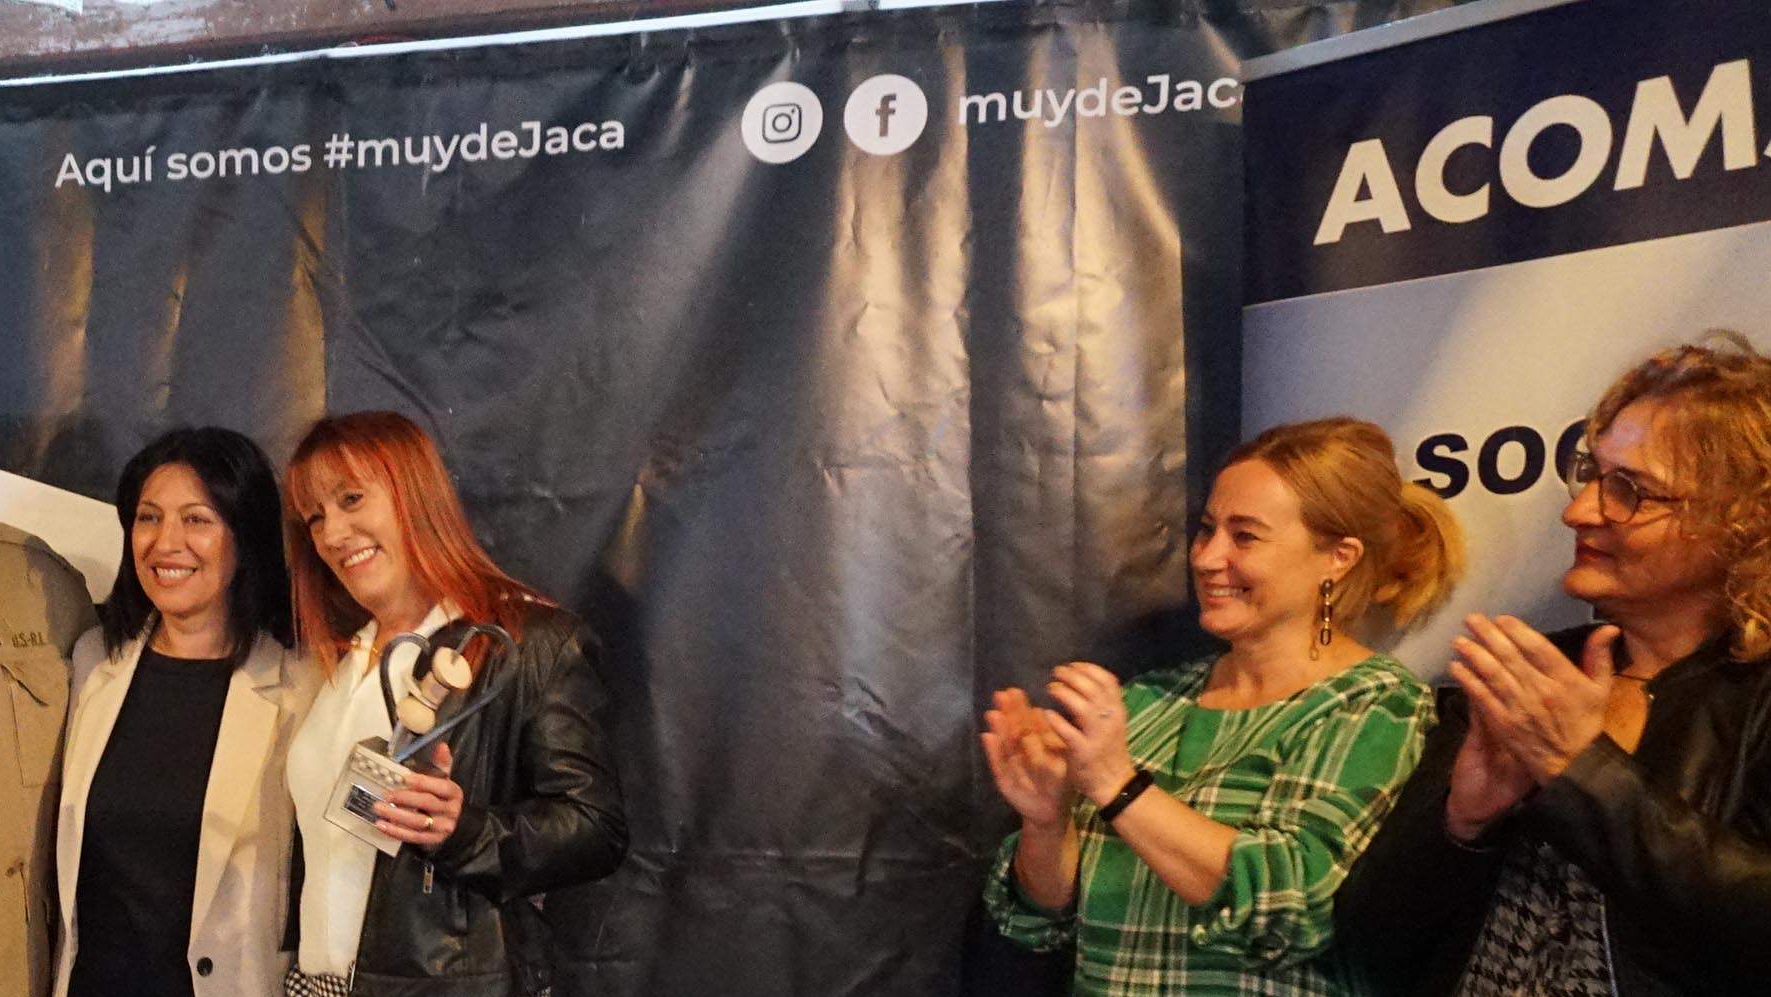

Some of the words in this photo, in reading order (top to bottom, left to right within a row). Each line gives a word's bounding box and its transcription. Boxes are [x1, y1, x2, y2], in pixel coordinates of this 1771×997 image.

[958, 73, 1244, 128] muydeJac
[54, 144, 156, 192] Aquí
[166, 143, 312, 181] somos
[324, 119, 626, 172] #muydeJaca
[1313, 58, 1771, 246] ACOM
